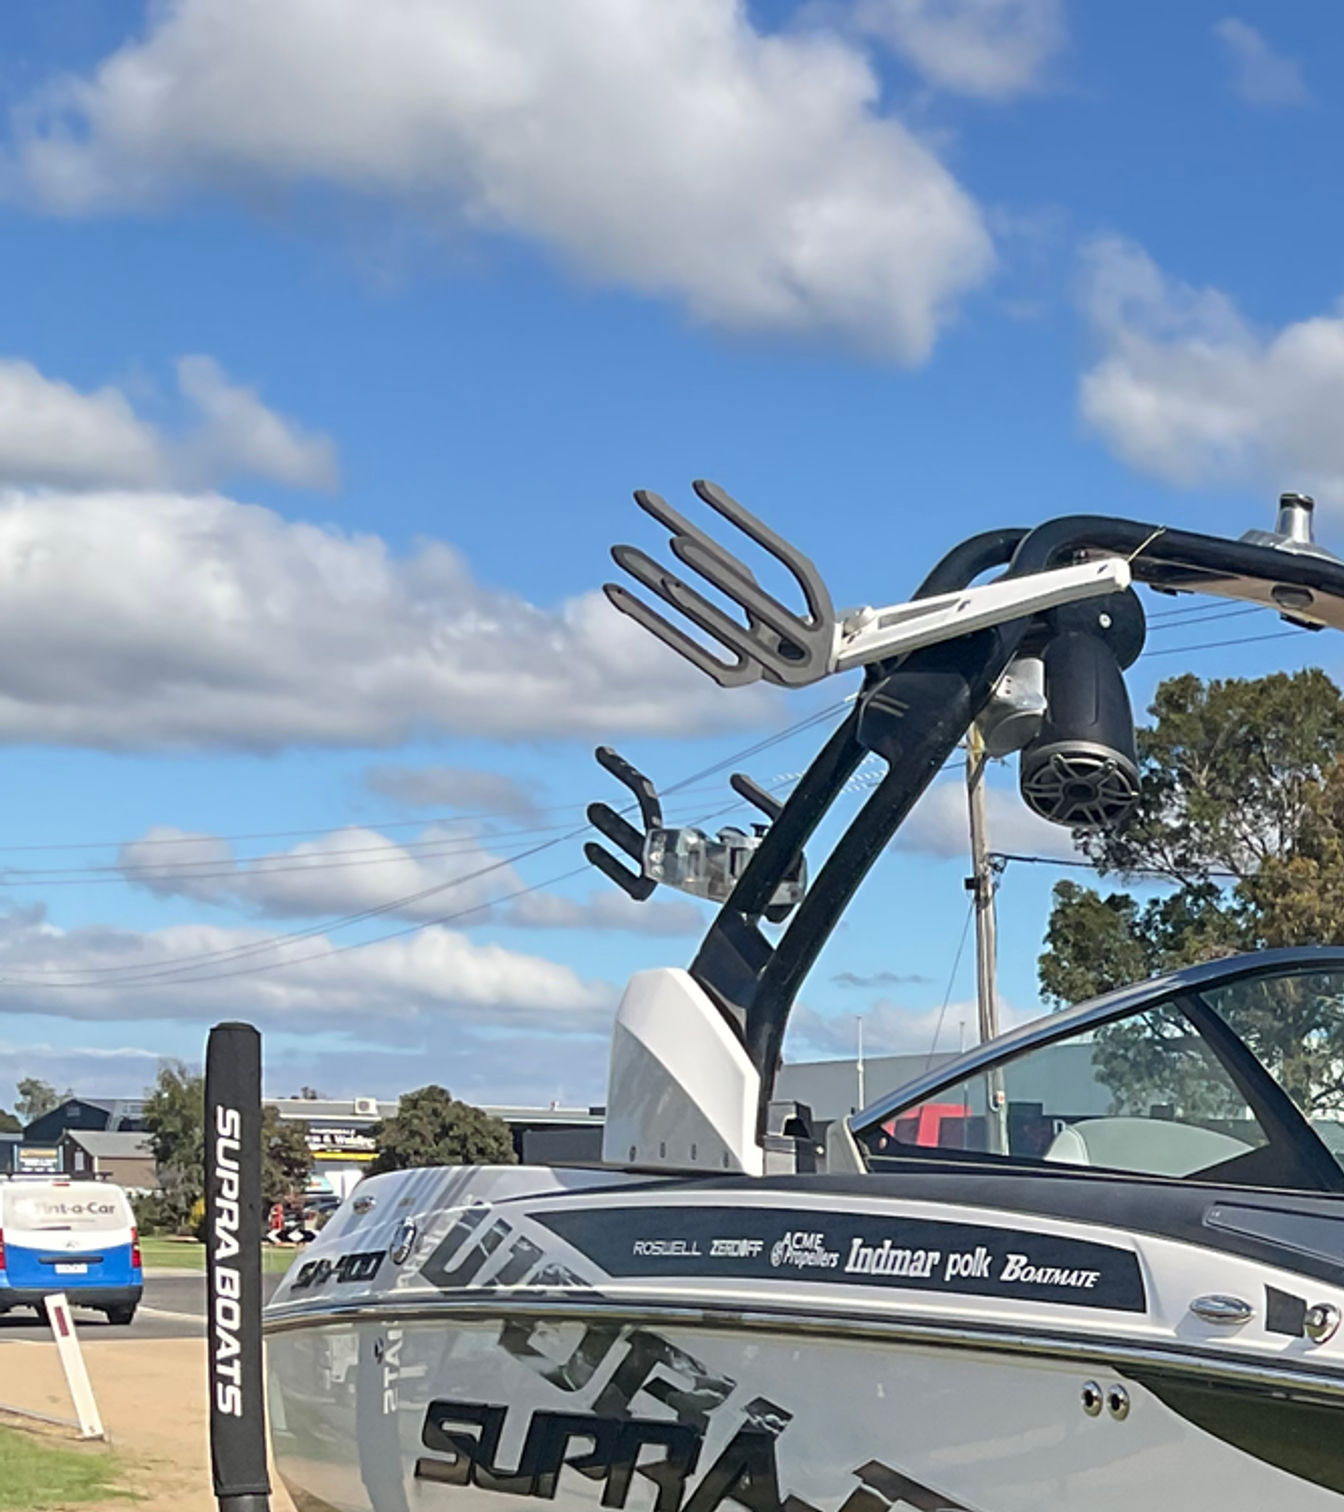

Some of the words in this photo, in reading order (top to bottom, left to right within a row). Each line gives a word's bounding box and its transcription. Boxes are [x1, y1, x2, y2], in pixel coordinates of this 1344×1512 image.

[215, 1105, 241, 1260] SUPRA
[782, 1232, 824, 1248] ACME
[783, 1247, 840, 1269] Propellers
[844, 1238, 942, 1278] Indmar
[945, 1246, 993, 1282] polk
[1000, 1253, 1100, 1288] BOATMATE
[215, 1265, 242, 1417] BOATS
